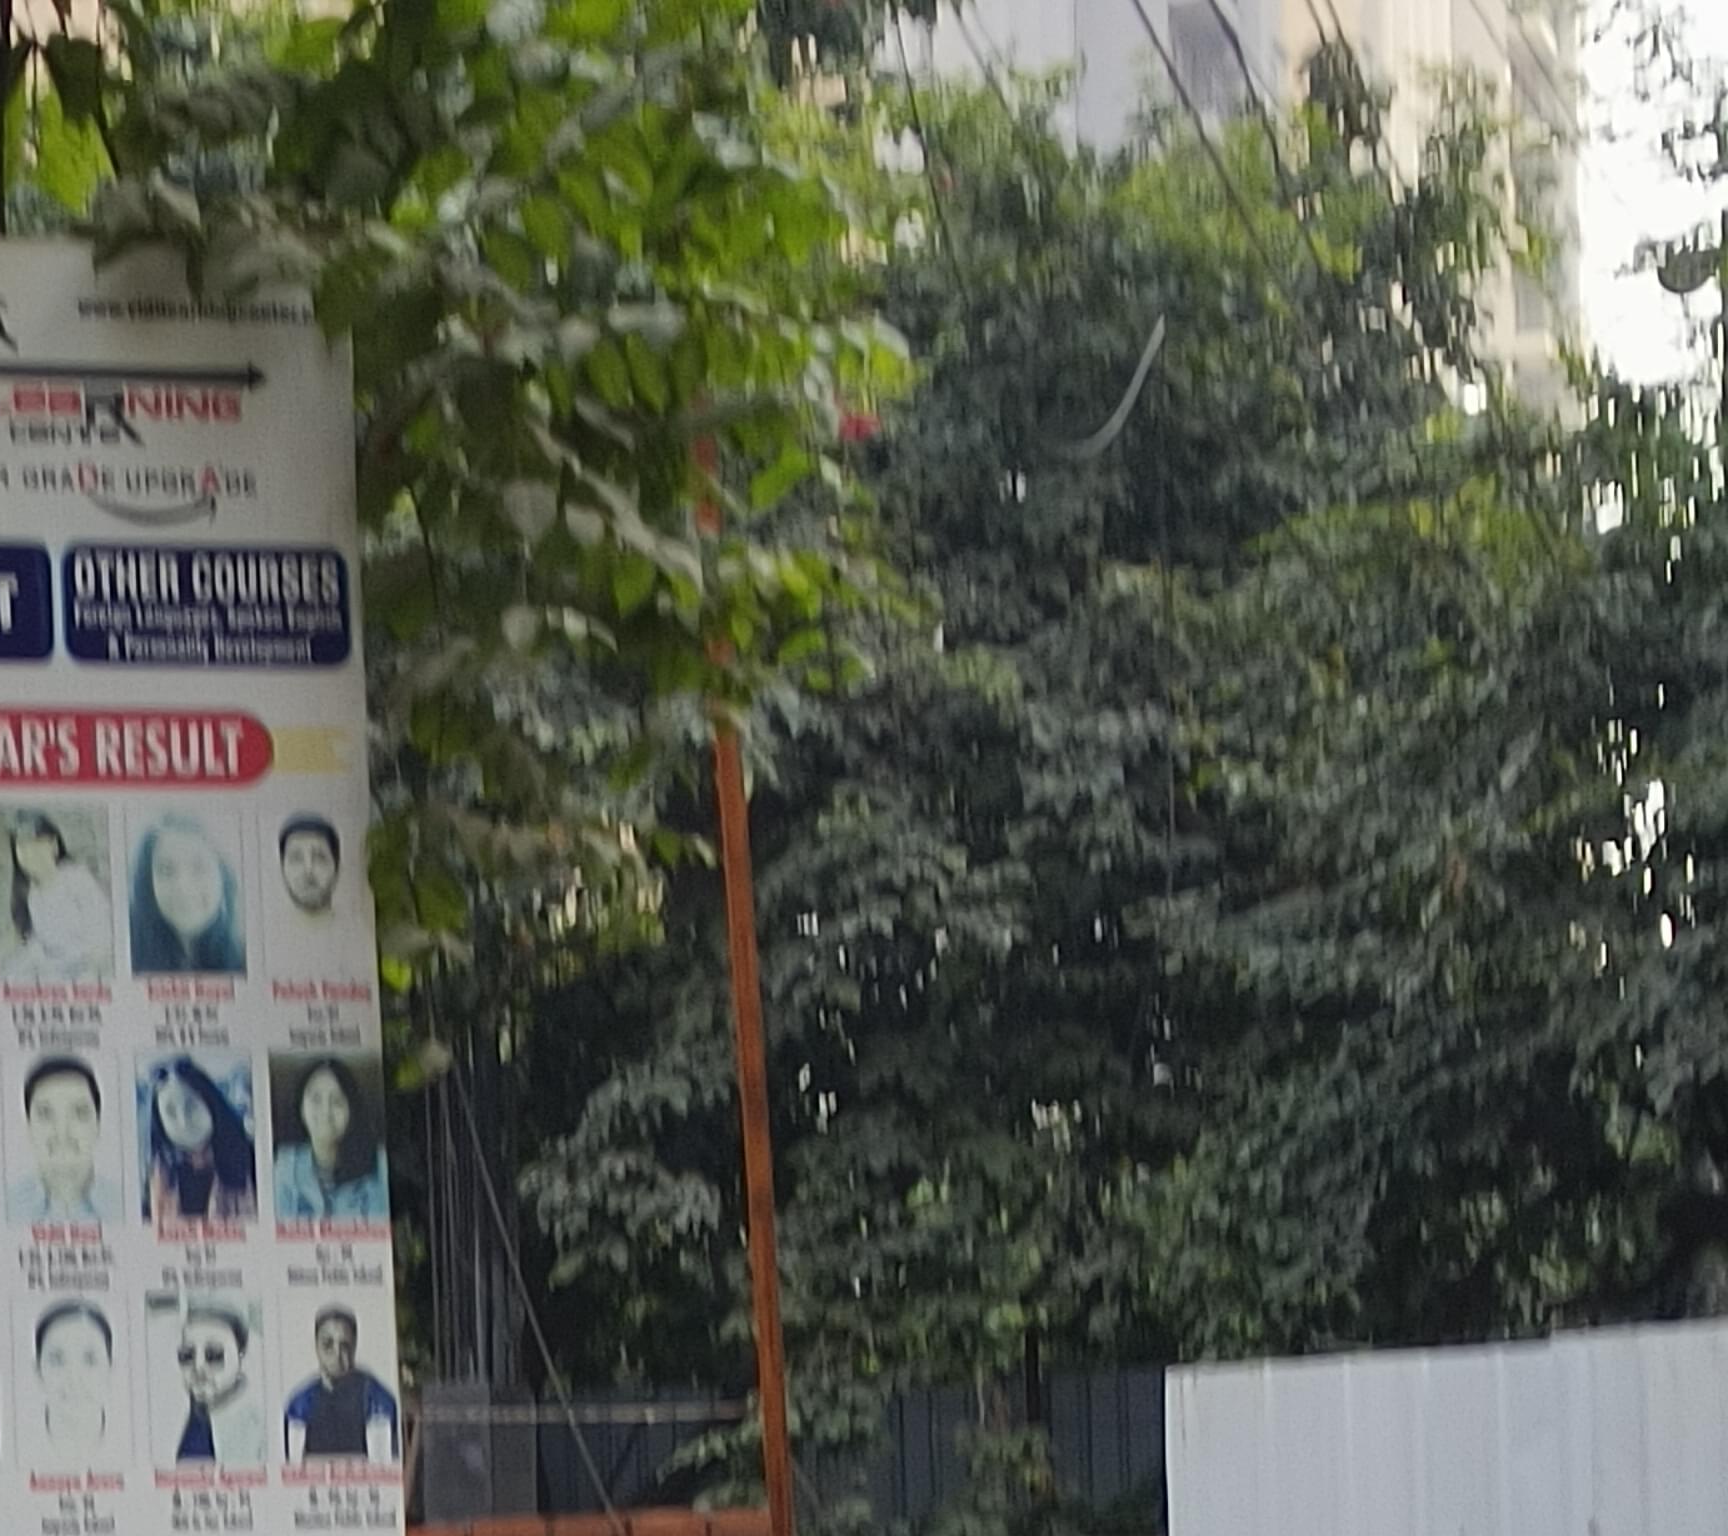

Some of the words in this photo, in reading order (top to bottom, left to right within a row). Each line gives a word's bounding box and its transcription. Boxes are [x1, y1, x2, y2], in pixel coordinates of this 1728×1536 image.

[22, 461, 117, 496] GRADE
[125, 464, 257, 500] UPGRADE
[73, 547, 180, 602] OTHER
[191, 550, 340, 605] COURSES
[95, 716, 245, 779] RESULT
